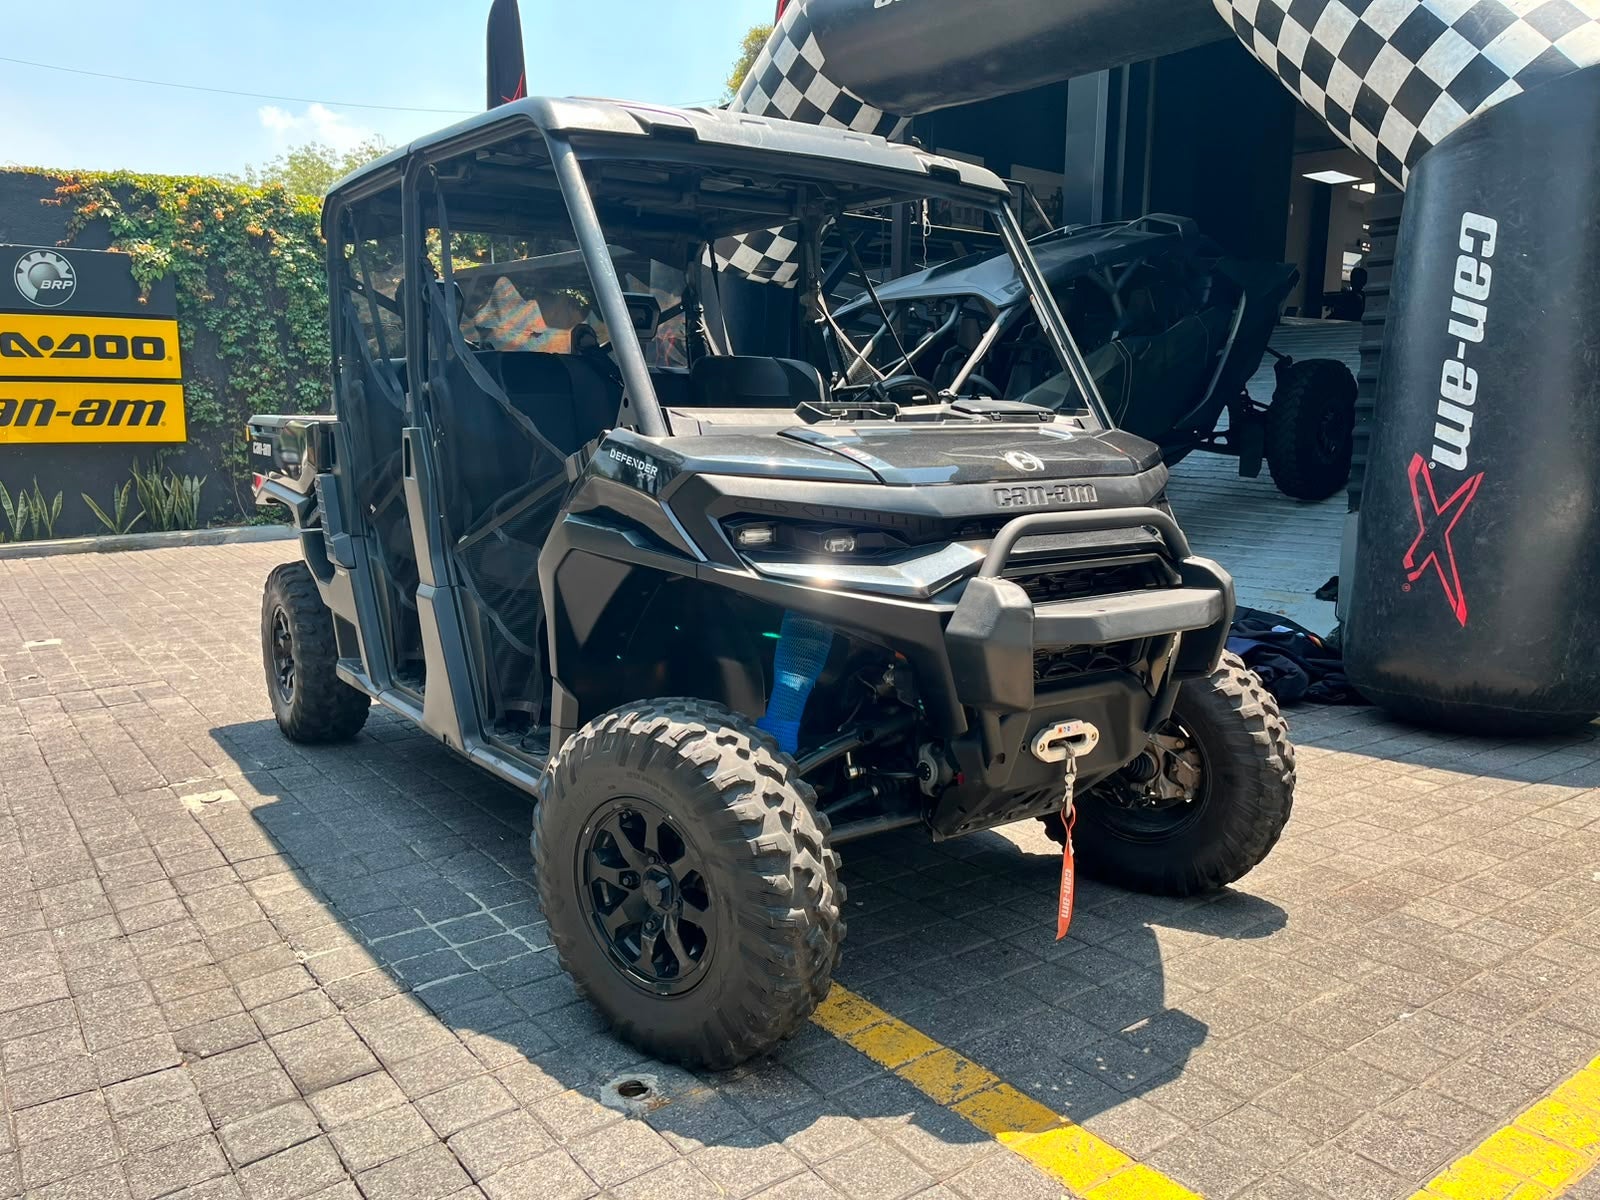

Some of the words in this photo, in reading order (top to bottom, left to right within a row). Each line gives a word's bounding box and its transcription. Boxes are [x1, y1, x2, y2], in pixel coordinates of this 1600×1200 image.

[40, 280, 74, 290] BRP
[1431, 211, 1498, 472] can-am
[0, 398, 167, 427] an-am
[609, 447, 659, 477] DEFENDER
[993, 483, 1098, 508] can-am
